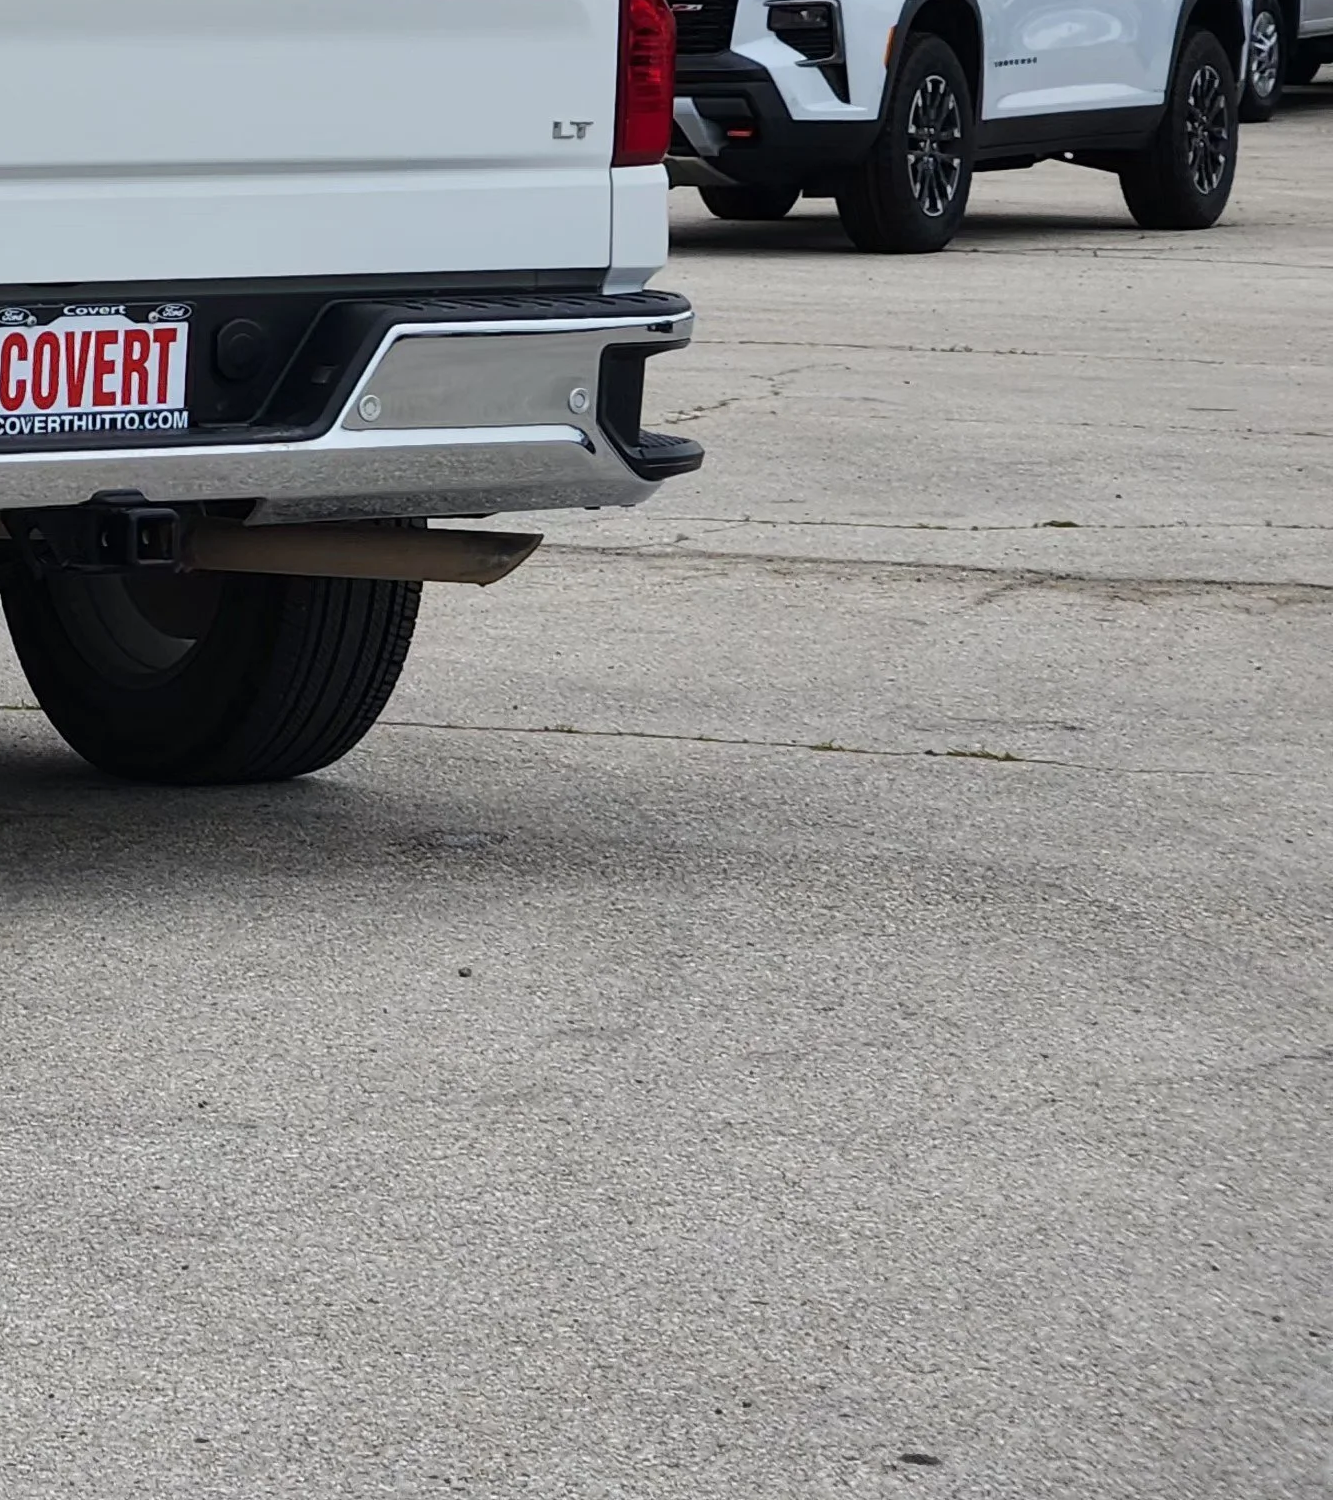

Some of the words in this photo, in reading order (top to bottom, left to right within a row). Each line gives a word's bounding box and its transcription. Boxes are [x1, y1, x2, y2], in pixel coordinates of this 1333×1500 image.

[552, 120, 594, 140] LT
[63, 305, 126, 316] Covert
[0, 328, 178, 411] COVERT
